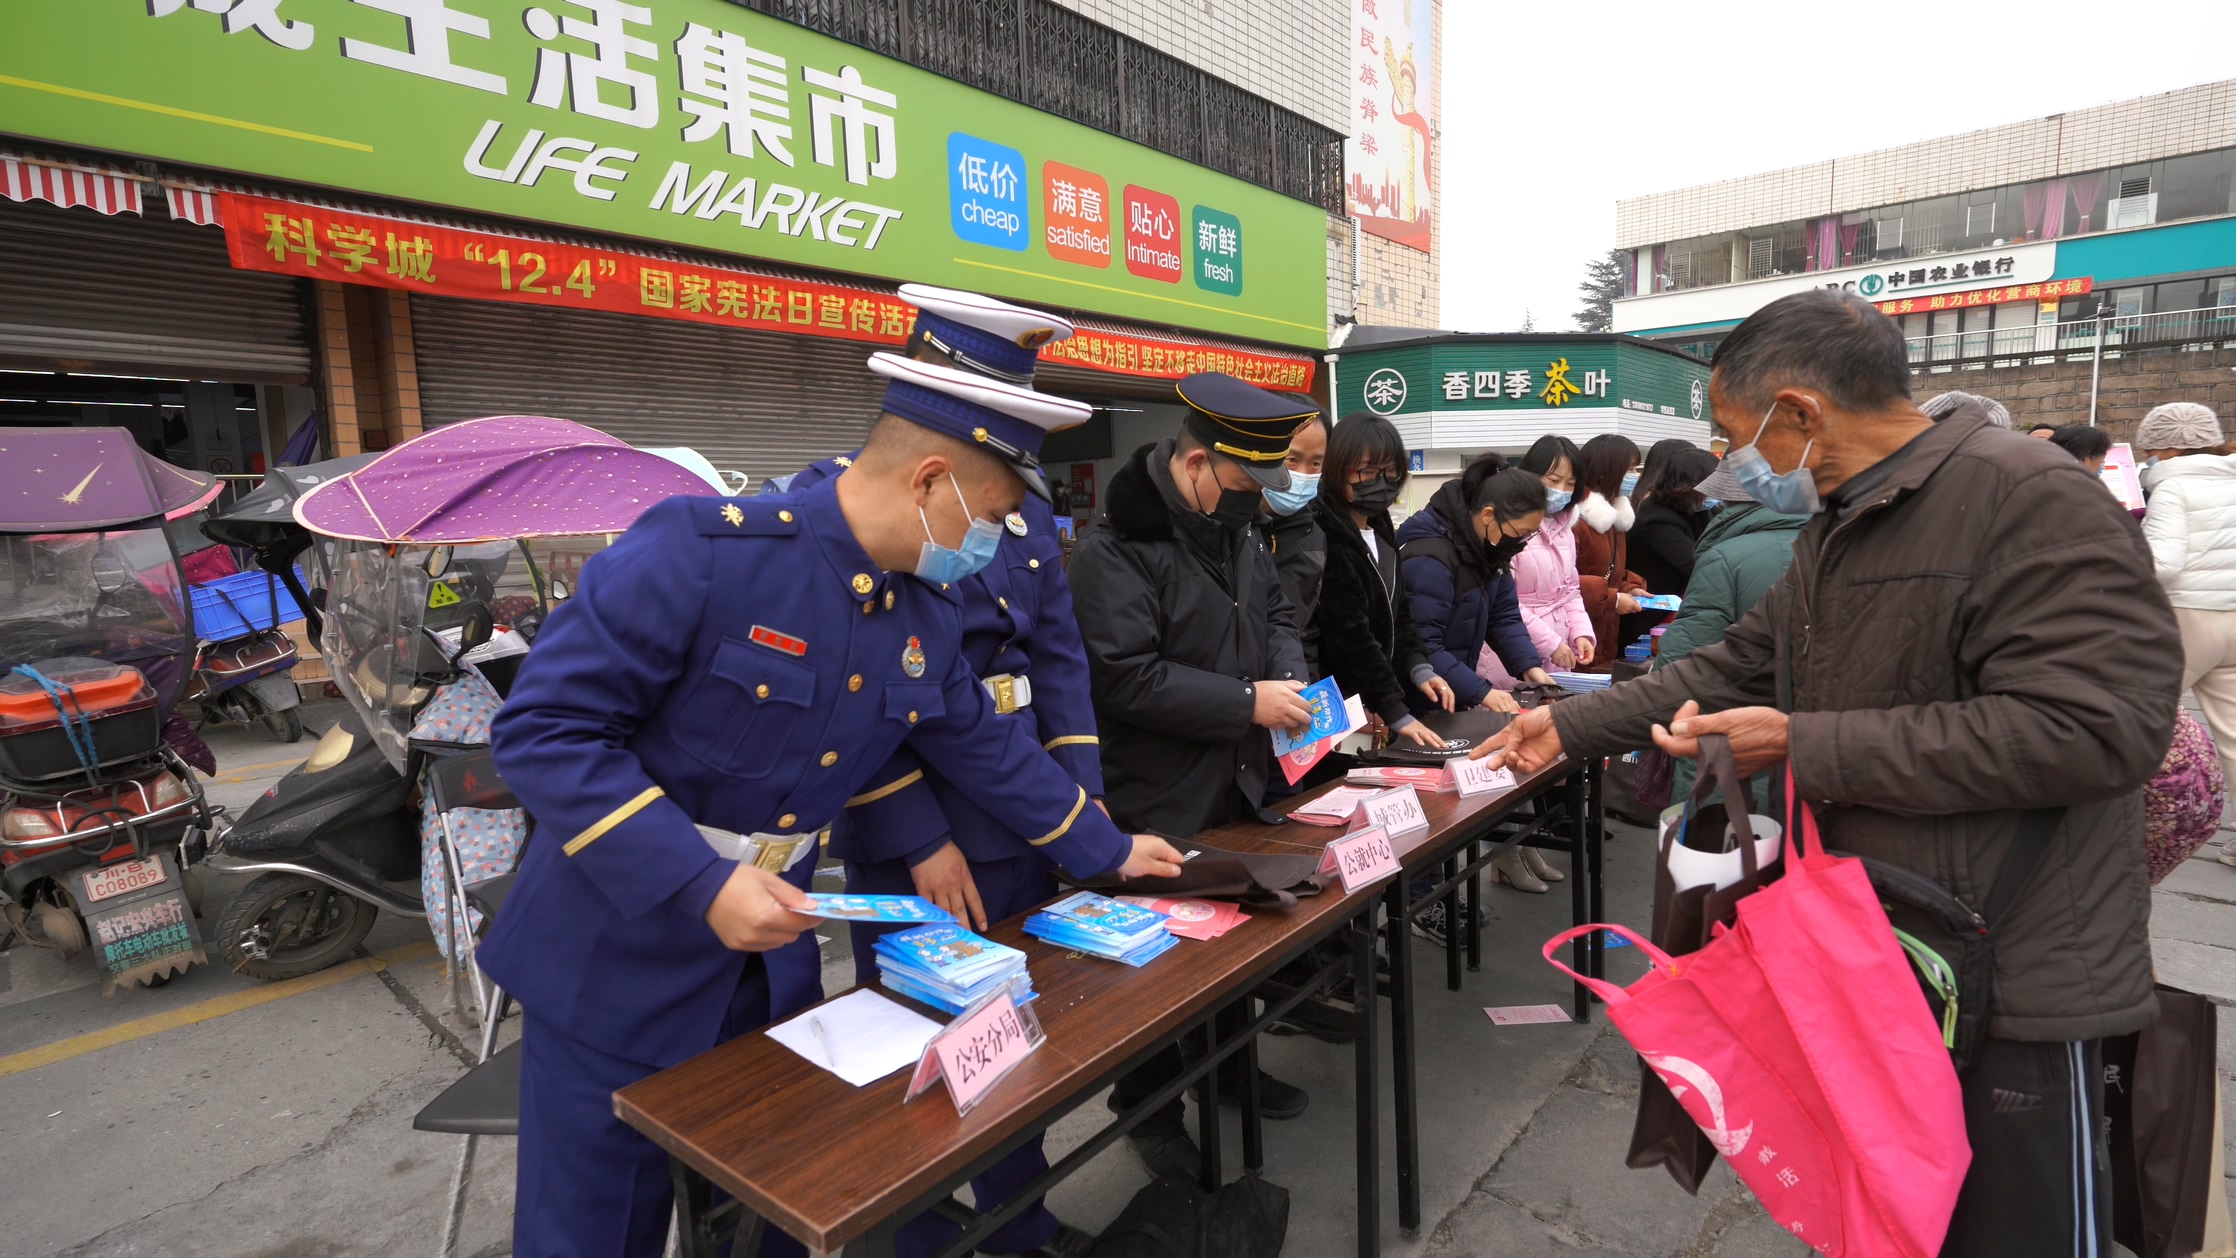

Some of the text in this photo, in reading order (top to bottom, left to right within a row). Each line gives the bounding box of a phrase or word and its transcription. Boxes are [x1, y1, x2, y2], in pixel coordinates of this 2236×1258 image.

[463, 120, 904, 251] LIFE MARKET
[958, 152, 1019, 202] 低价
[961, 199, 1020, 237] cheap
[1051, 178, 1103, 224] 满意
[1130, 200, 1175, 241] 贴心
[1198, 219, 1237, 258] 新鲜
[263, 212, 437, 284] 科学城
[1047, 225, 1110, 256] satisfied
[1127, 239, 1181, 271] Intimate
[1203, 258, 1234, 284] fresh
[1888, 256, 2016, 288] 中国农业银行
[1872, 278, 2085, 314] 服务 助力优化营商环境
[1367, 378, 1404, 406] 茶
[1441, 357, 1613, 407] 香四季茶叶
[1373, 799, 1418, 827] 城管办
[1343, 838, 1391, 877] 公就中心
[94, 869, 158, 897] C08089
[955, 1009, 1020, 1085] 公安分局
